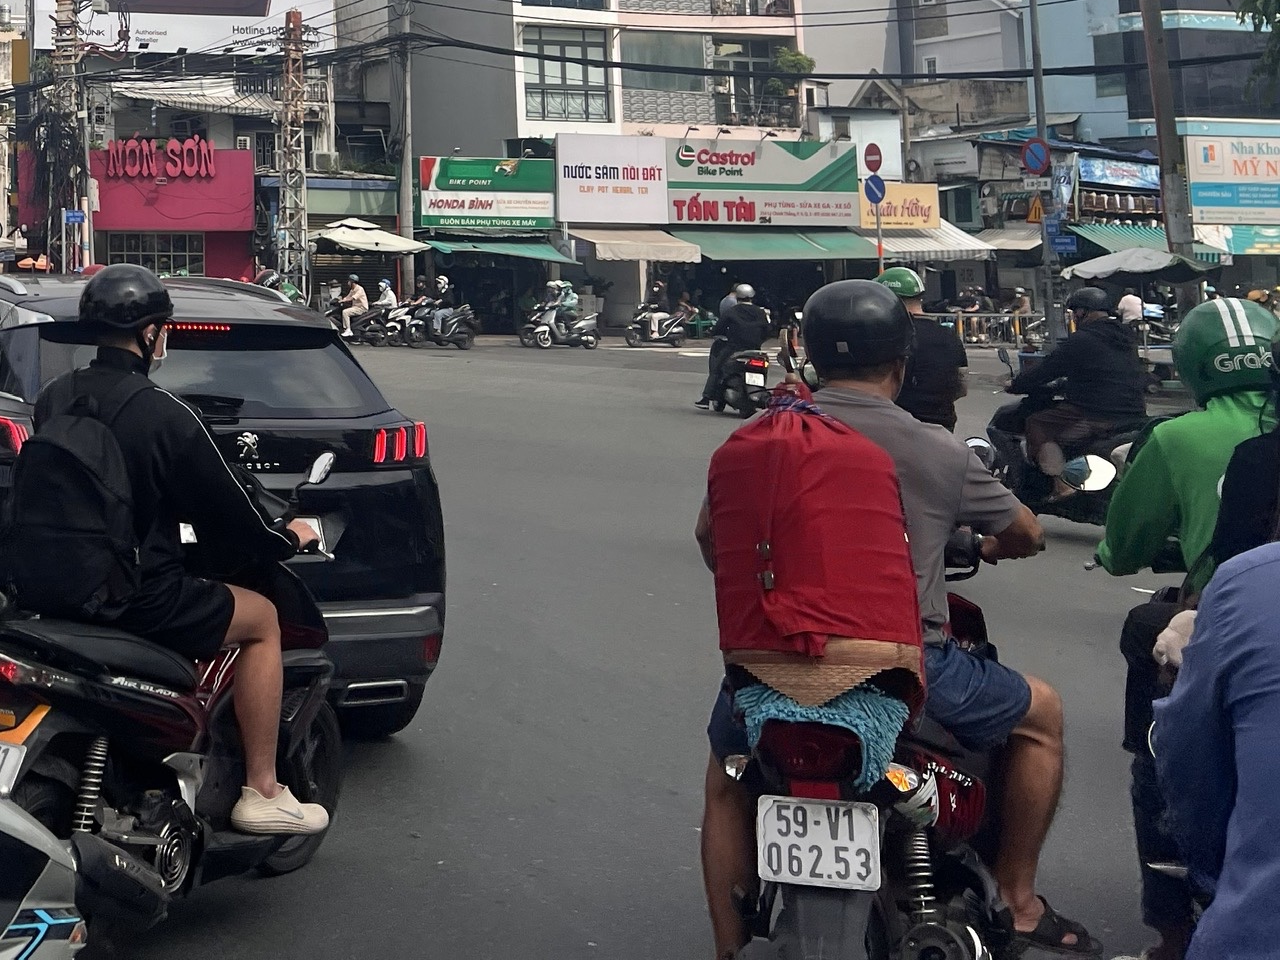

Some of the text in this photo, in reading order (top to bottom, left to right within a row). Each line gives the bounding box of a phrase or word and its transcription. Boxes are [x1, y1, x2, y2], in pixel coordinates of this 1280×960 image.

[232, 25, 265, 35] Hotline
[107, 131, 216, 178] NÓN SƠN
[697, 148, 756, 166] Castrol
[1231, 142, 1254, 155] Nha
[563, 162, 662, 181] NƯỚC SÂM NỒI ĐẤT
[697, 166, 743, 176] Bike Point
[1233, 156, 1260, 176] MỸ
[428, 197, 494, 210] HONDA BÌNH
[673, 192, 756, 222] TẤN TÀI
[440, 217, 460, 225] BUÔN
[461, 217, 476, 225] BÁN
[476, 219, 490, 227] PHỤ
[491, 217, 511, 226] TÙNG
[521, 217, 536, 226] MÁY
[140, 684, 180, 698] BLADE
[776, 805, 855, 842] 59-V1
[767, 842, 872, 881] 062.53
